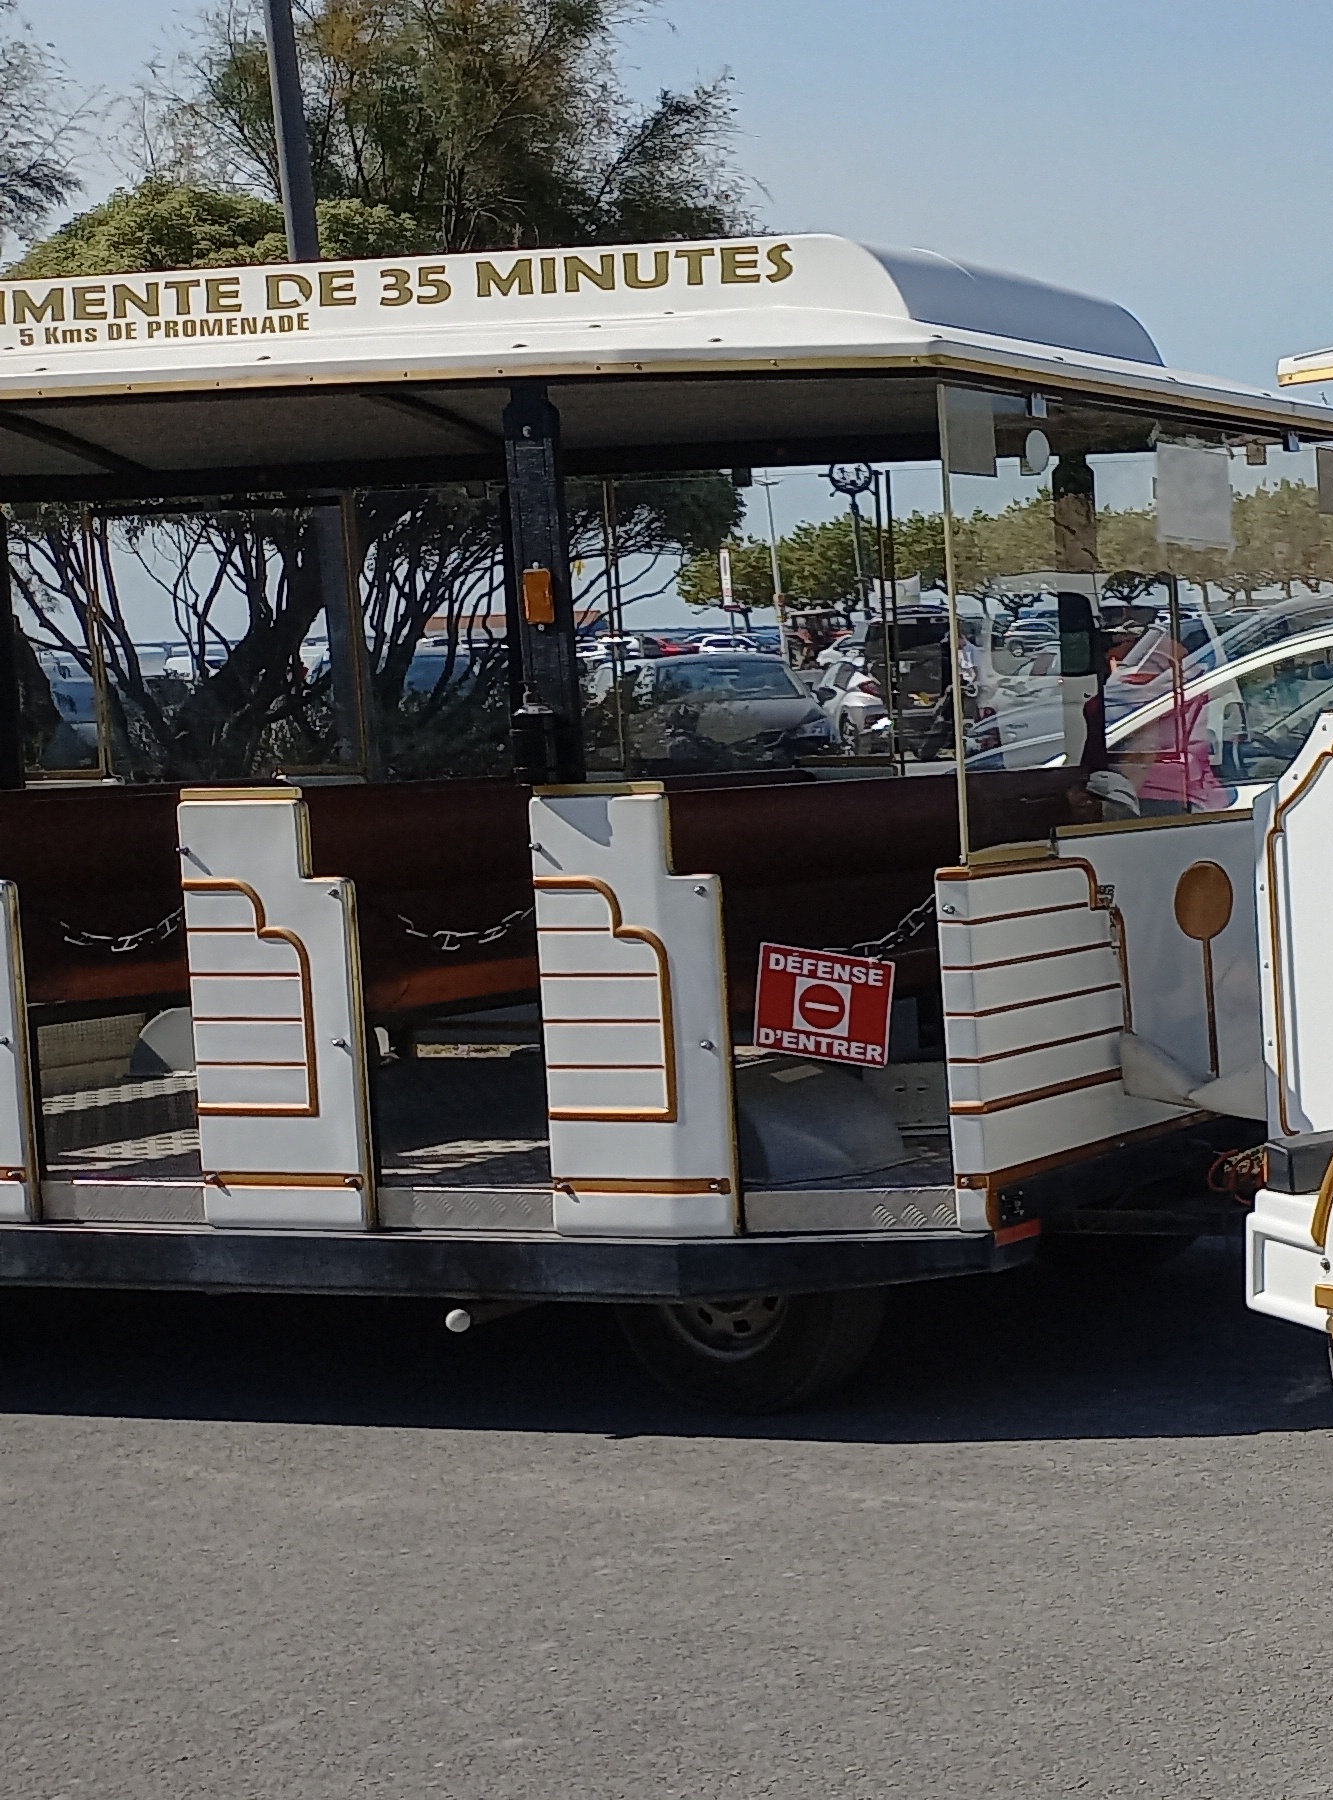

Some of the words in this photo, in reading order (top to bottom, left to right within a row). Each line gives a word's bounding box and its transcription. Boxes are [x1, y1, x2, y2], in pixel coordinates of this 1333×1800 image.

[0, 277, 243, 325] MENTE
[265, 270, 357, 310] DE
[380, 265, 452, 307] 35
[476, 243, 794, 298] MINUTES
[19, 328, 34, 346] 5
[45, 324, 98, 344] Kms
[107, 322, 137, 341] DE
[147, 312, 310, 339] PROMENADE
[769, 952, 884, 987] DÉFENSE
[759, 1028, 882, 1062] D'ENTRER
